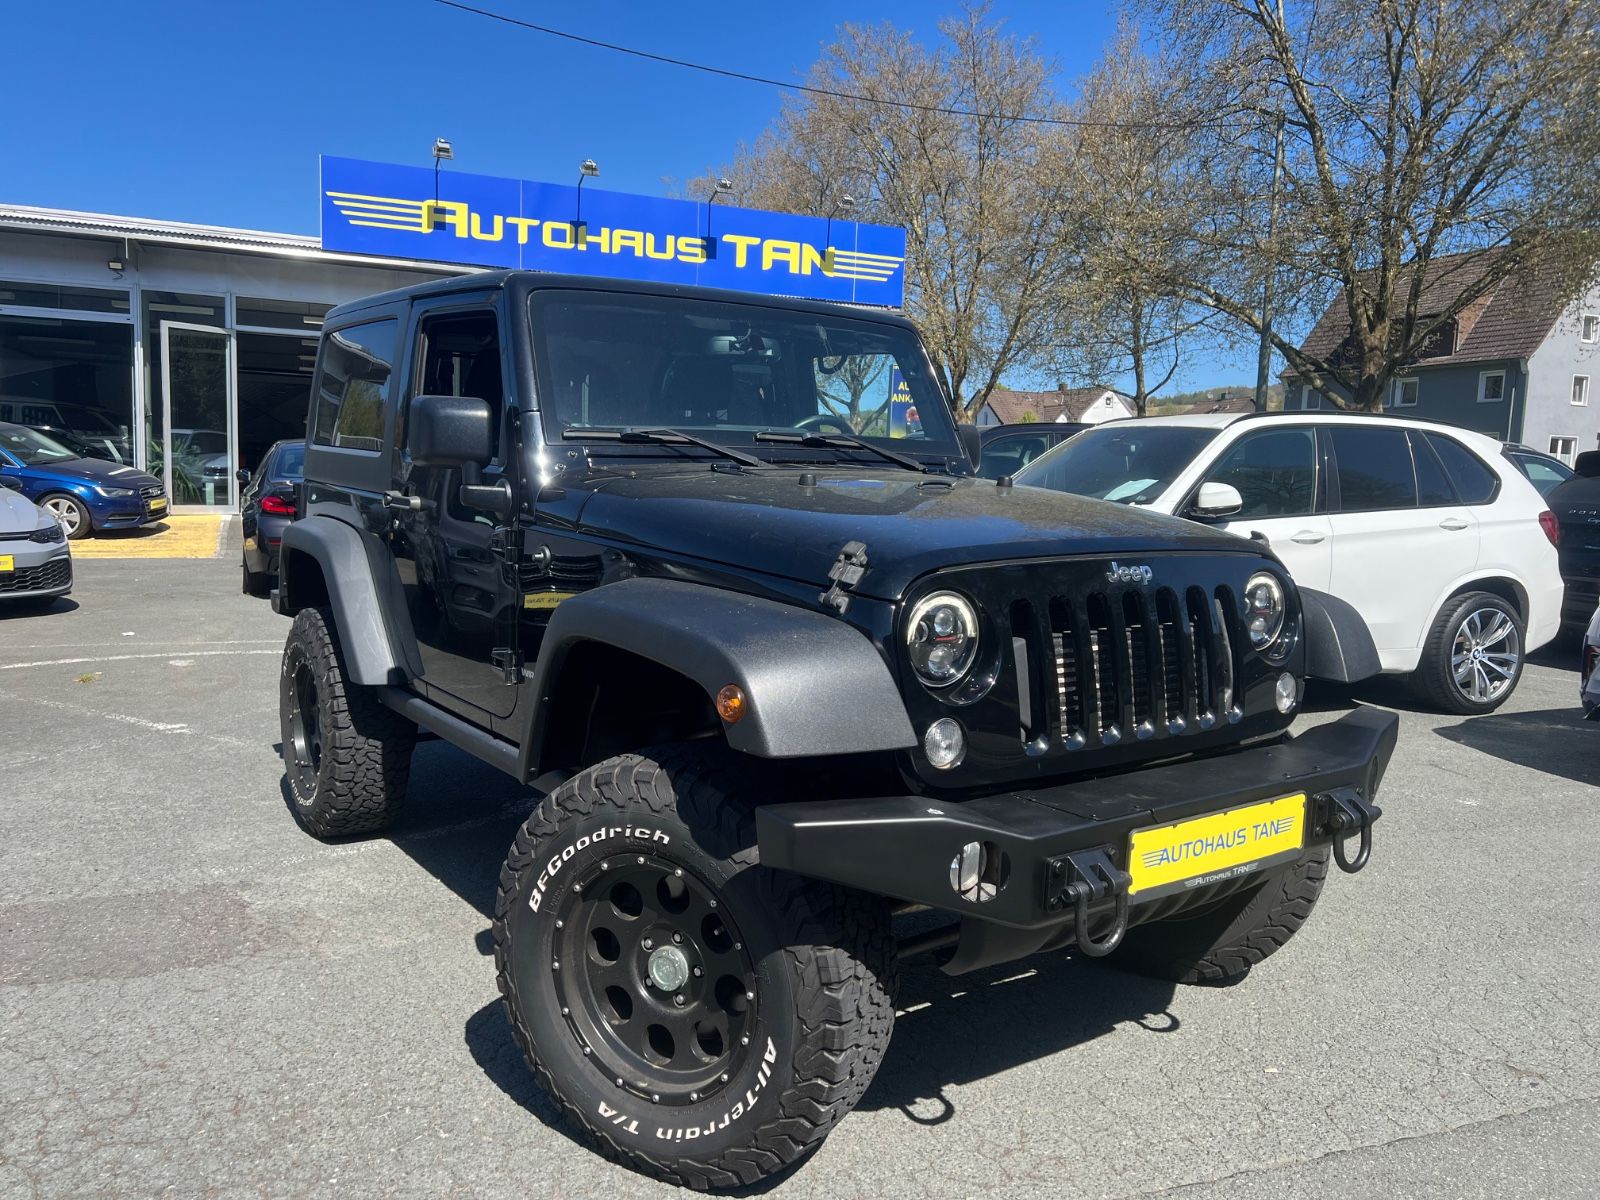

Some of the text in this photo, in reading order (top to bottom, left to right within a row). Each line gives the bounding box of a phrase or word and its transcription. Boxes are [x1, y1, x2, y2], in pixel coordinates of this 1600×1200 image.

[421, 199, 836, 278] AUTOHAUS TAN
[891, 393, 914, 403] ANK
[1106, 561, 1153, 585] Jeep
[1159, 819, 1281, 866] AUTOHAUS TAN
[528, 824, 671, 913] BFGoodrich
[1194, 864, 1250, 886] AUTOHAUS TAN
[597, 1036, 777, 1143] All-Terrain T/A
